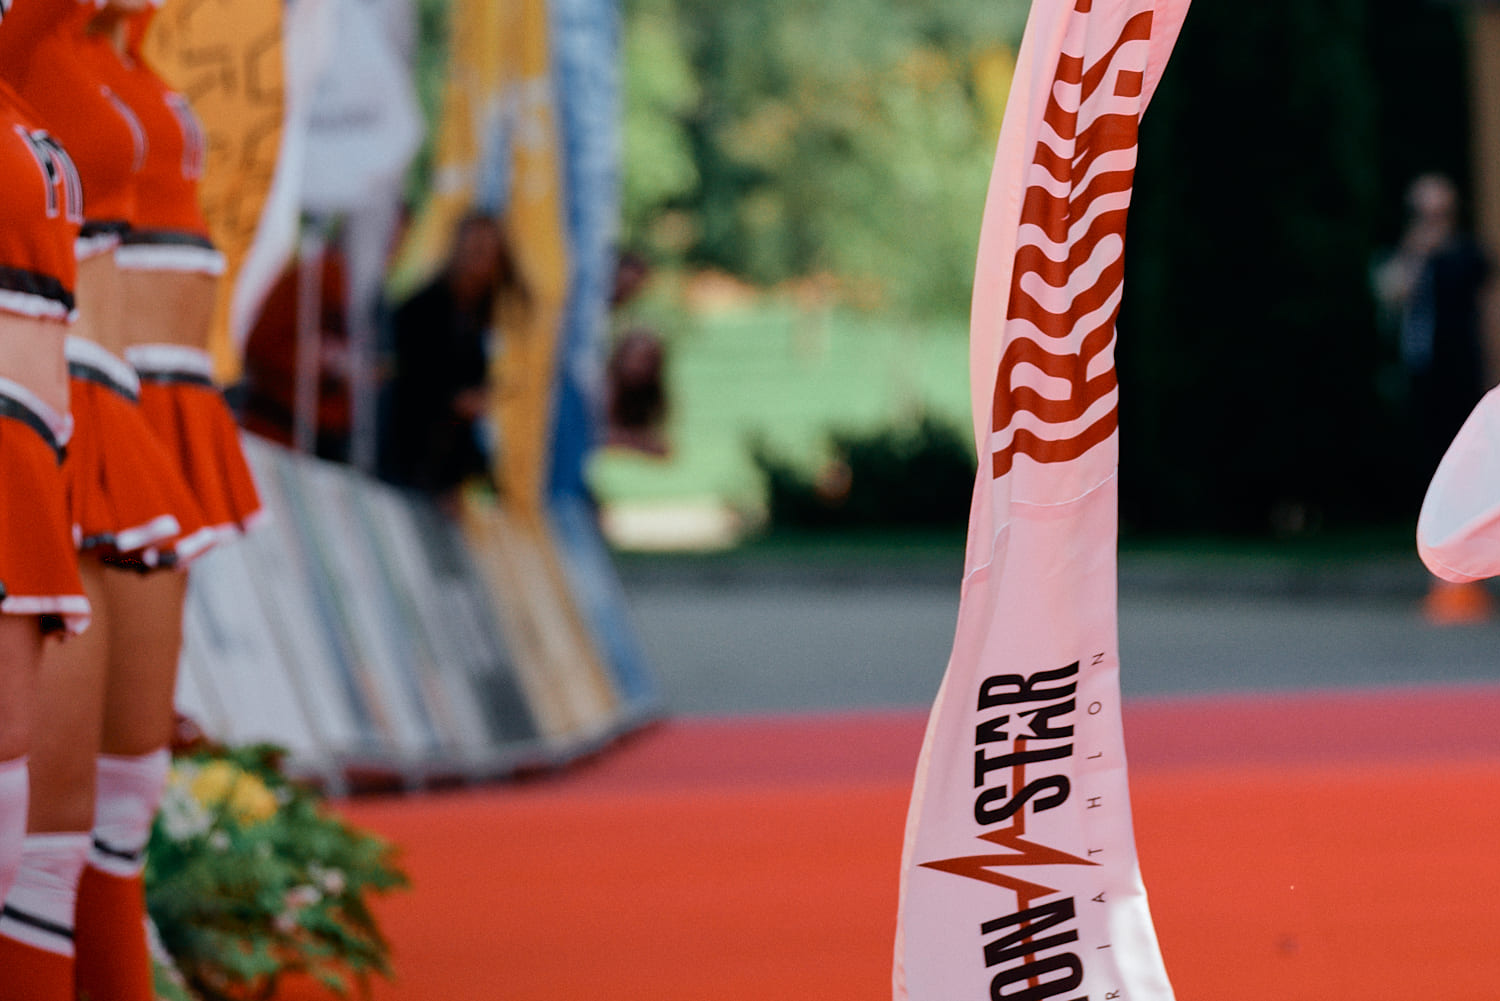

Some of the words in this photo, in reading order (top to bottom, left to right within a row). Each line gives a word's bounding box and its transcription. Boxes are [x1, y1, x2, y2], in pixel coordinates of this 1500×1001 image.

[974, 660, 1080, 826] STAR
[1087, 651, 1121, 1001] RIATHLON
[981, 896, 1089, 1001] ON
